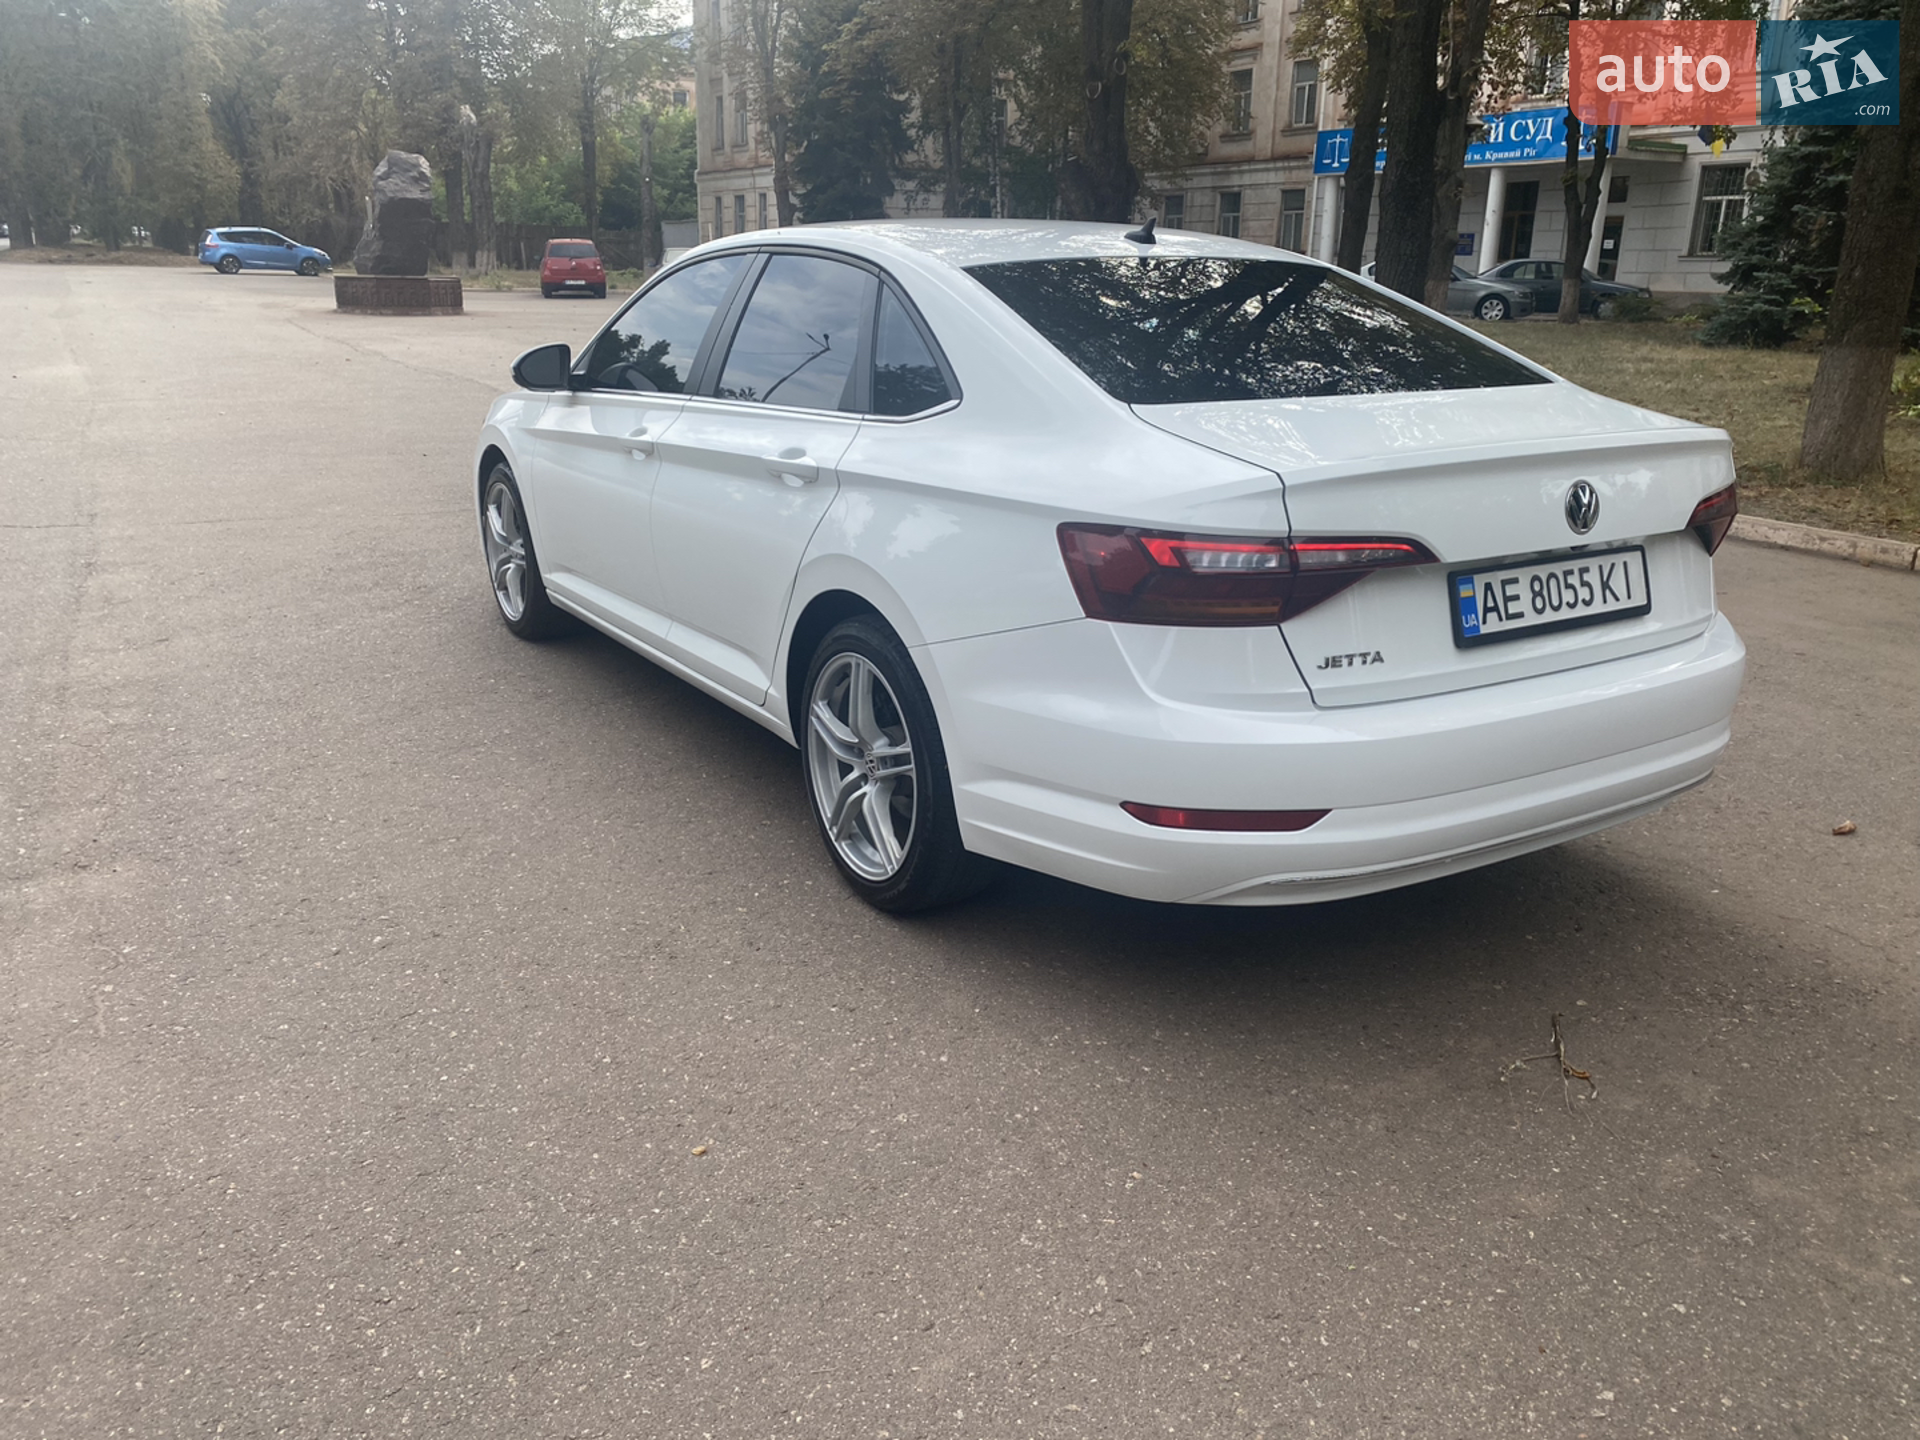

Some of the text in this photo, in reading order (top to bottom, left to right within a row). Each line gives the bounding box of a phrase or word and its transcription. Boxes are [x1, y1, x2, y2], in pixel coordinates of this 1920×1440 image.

[1509, 116, 1554, 144] СУД
[1481, 560, 1632, 625] AE 8055 KI
[1462, 613, 1479, 628] UA
[1316, 650, 1385, 670] JETTA
